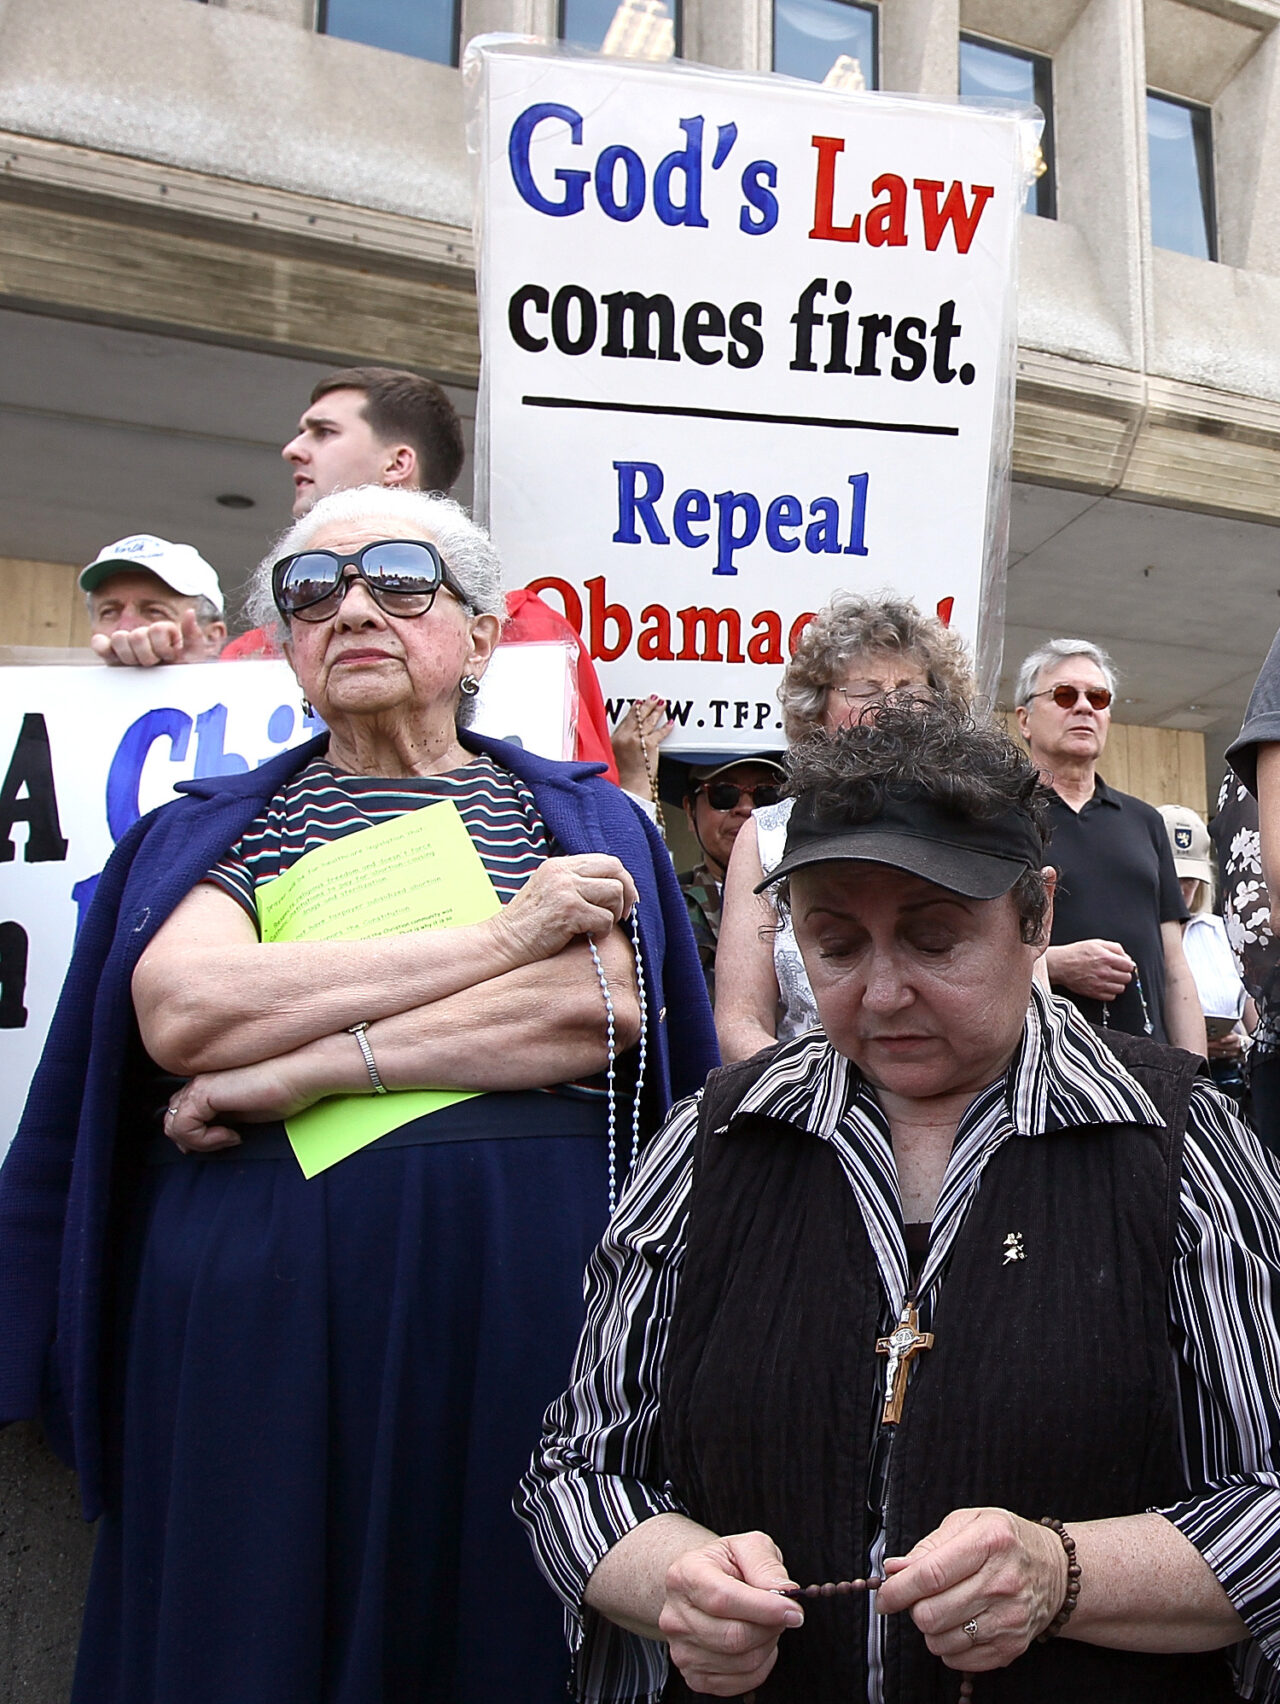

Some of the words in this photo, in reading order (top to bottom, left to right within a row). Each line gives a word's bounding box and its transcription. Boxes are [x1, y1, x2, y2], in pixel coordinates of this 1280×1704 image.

[509, 102, 778, 235] God's
[809, 135, 994, 254] Law
[509, 284, 763, 369] comes
[790, 278, 975, 385] first.
[613, 461, 869, 575] Repeal
[523, 576, 954, 664] Obamac
[0, 712, 69, 863] A
